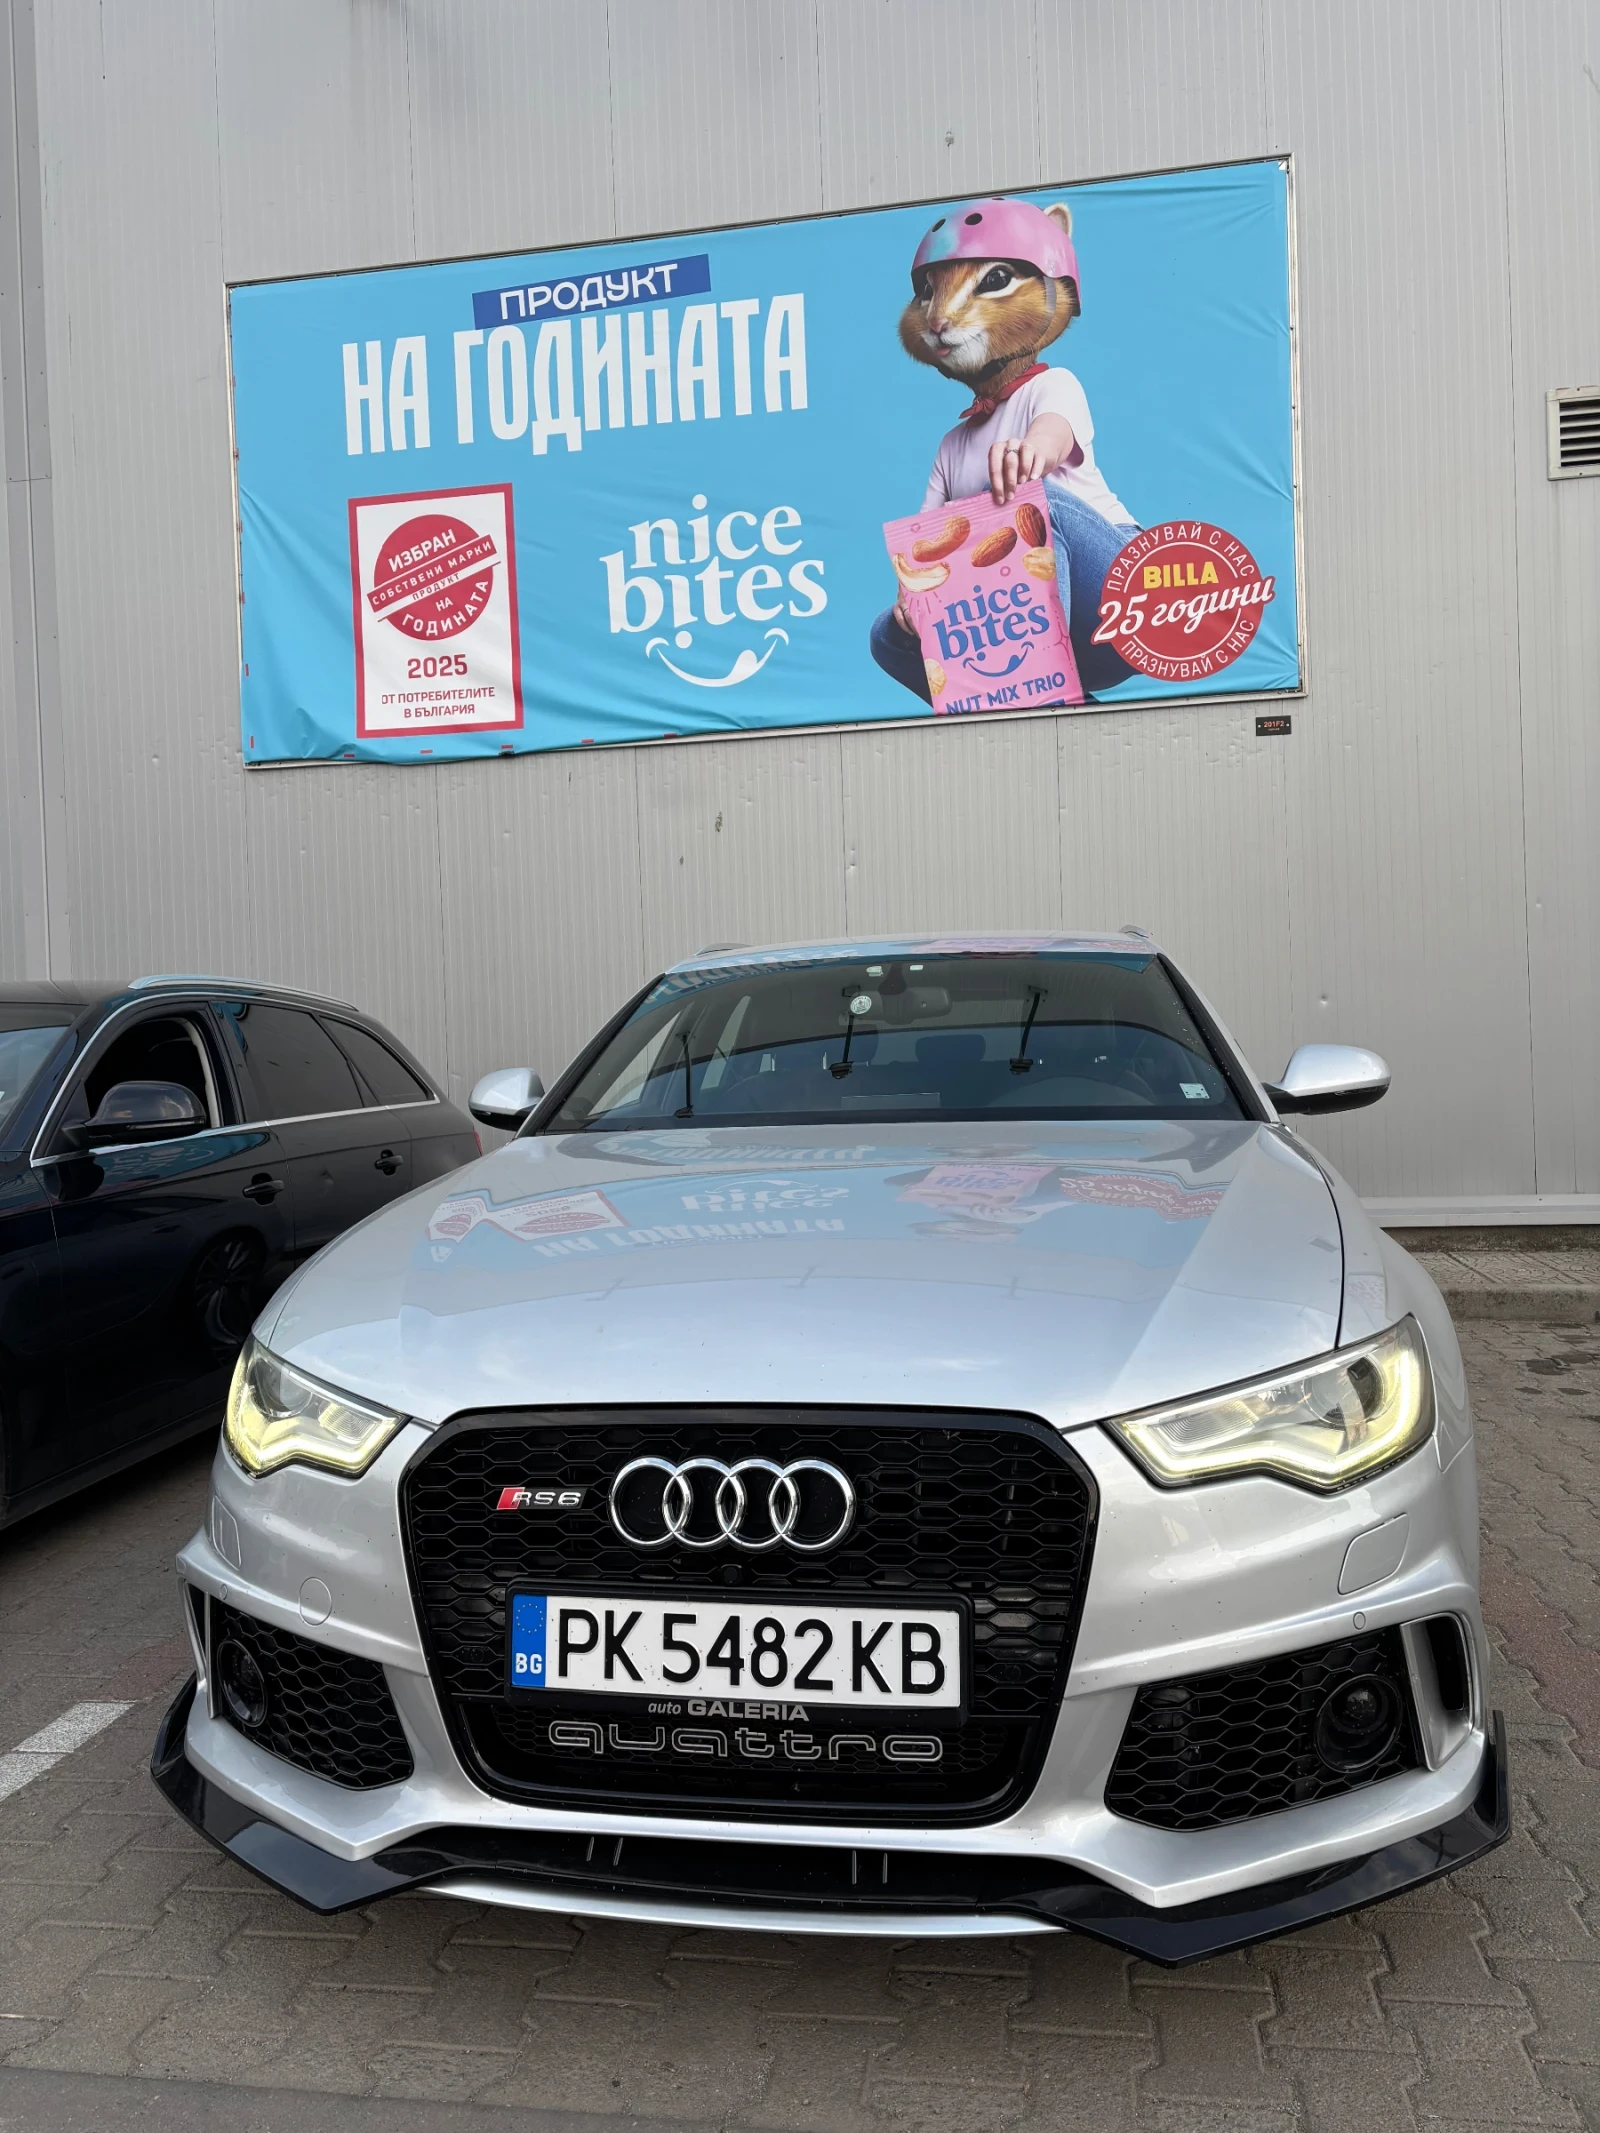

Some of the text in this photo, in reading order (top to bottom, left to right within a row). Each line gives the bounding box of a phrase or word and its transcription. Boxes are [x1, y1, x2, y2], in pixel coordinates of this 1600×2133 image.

[499, 263, 678, 320] ПРОДУКТ
[342, 293, 808, 456] НА ГОДИНАТА
[388, 529, 457, 573] ИЗБРАН
[628, 494, 803, 569] nice
[372, 541, 492, 606] СОБСТВЕНИ МАРКИ
[1107, 521, 1255, 591] ПРАЗНУВАЙ С НАС
[1143, 561, 1219, 589] BILLA
[402, 580, 489, 636] ГОДИНАТА
[412, 572, 461, 601] ПРОДУКТ
[435, 596, 454, 612] НА
[599, 550, 828, 649] bites
[944, 583, 1032, 628] nice
[1093, 578, 1273, 642] 25 години
[932, 605, 1050, 661] bites
[1121, 620, 1254, 678] ПРАЗНУВАЙ С НАС
[407, 654, 468, 679] 2025
[381, 687, 496, 704] ОТ ПОТРЕБИТЕЛИТЕ
[404, 704, 475, 718] В БЪЛГАРИЯ
[945, 672, 1066, 714] NUT MIX TRIO
[510, 1491, 582, 1507] RS6
[515, 1652, 542, 1674] BG
[557, 1608, 946, 1695] PK 5482 KB
[647, 1699, 810, 1722] auto GALERIA
[548, 1720, 943, 1762] quattro
